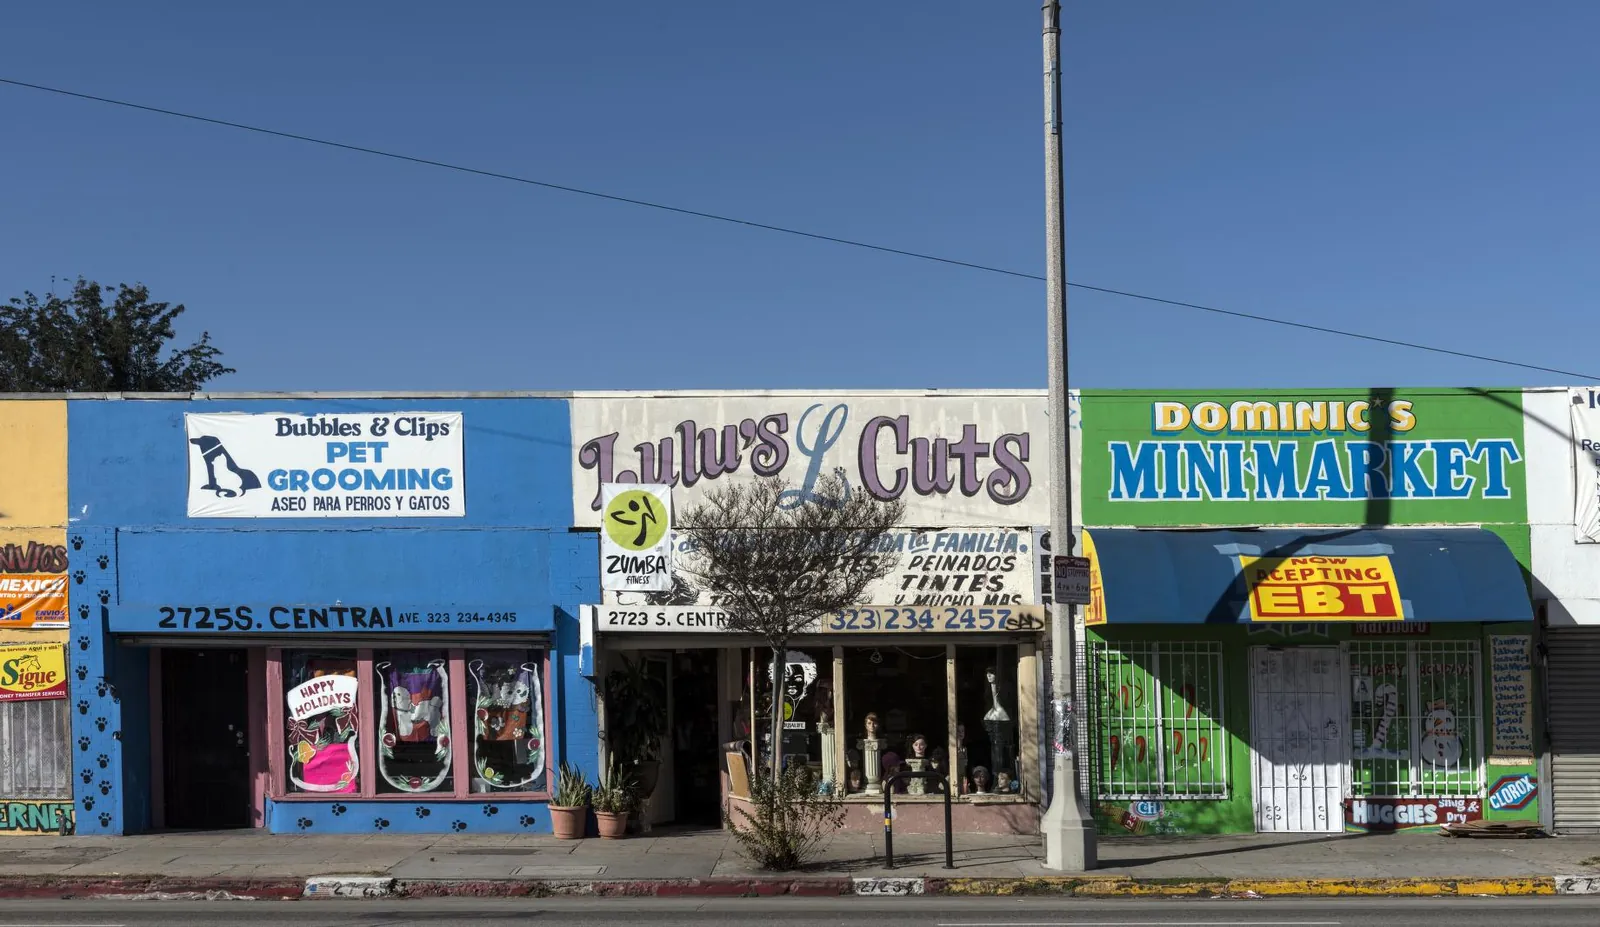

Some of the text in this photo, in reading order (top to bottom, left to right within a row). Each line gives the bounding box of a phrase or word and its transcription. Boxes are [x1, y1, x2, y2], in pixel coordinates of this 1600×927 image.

[275, 417, 450, 442] Bubbles & Clips
[326, 441, 389, 463] PET
[857, 414, 1032, 506] Cuts
[267, 467, 453, 492] GROOMING
[271, 496, 450, 512] ASEO PARA PERROS Y GATOS
[932, 532, 1028, 553] FAMILIA.
[605, 555, 667, 575] ZUMBA
[908, 555, 1017, 572] PEINADOS
[1291, 556, 1347, 566] NOW
[901, 574, 1004, 592] TINTES
[1256, 567, 1381, 582] ACEPTING
[1257, 585, 1386, 614] EBT
[399, 613, 422, 624] AVE.
[427, 614, 450, 624] 323
[457, 613, 517, 624] 234-4345
[608, 611, 648, 626] 2723
[655, 612, 671, 626] S.
[1, 659, 56, 690] Sigue
[300, 680, 335, 698] HAPPY
[295, 693, 351, 717] HOLIDAYS
[1489, 776, 1535, 809] CLOROX
[1353, 798, 1480, 825] HUGGIES Snug &
[1446, 812, 1467, 824] Dry
